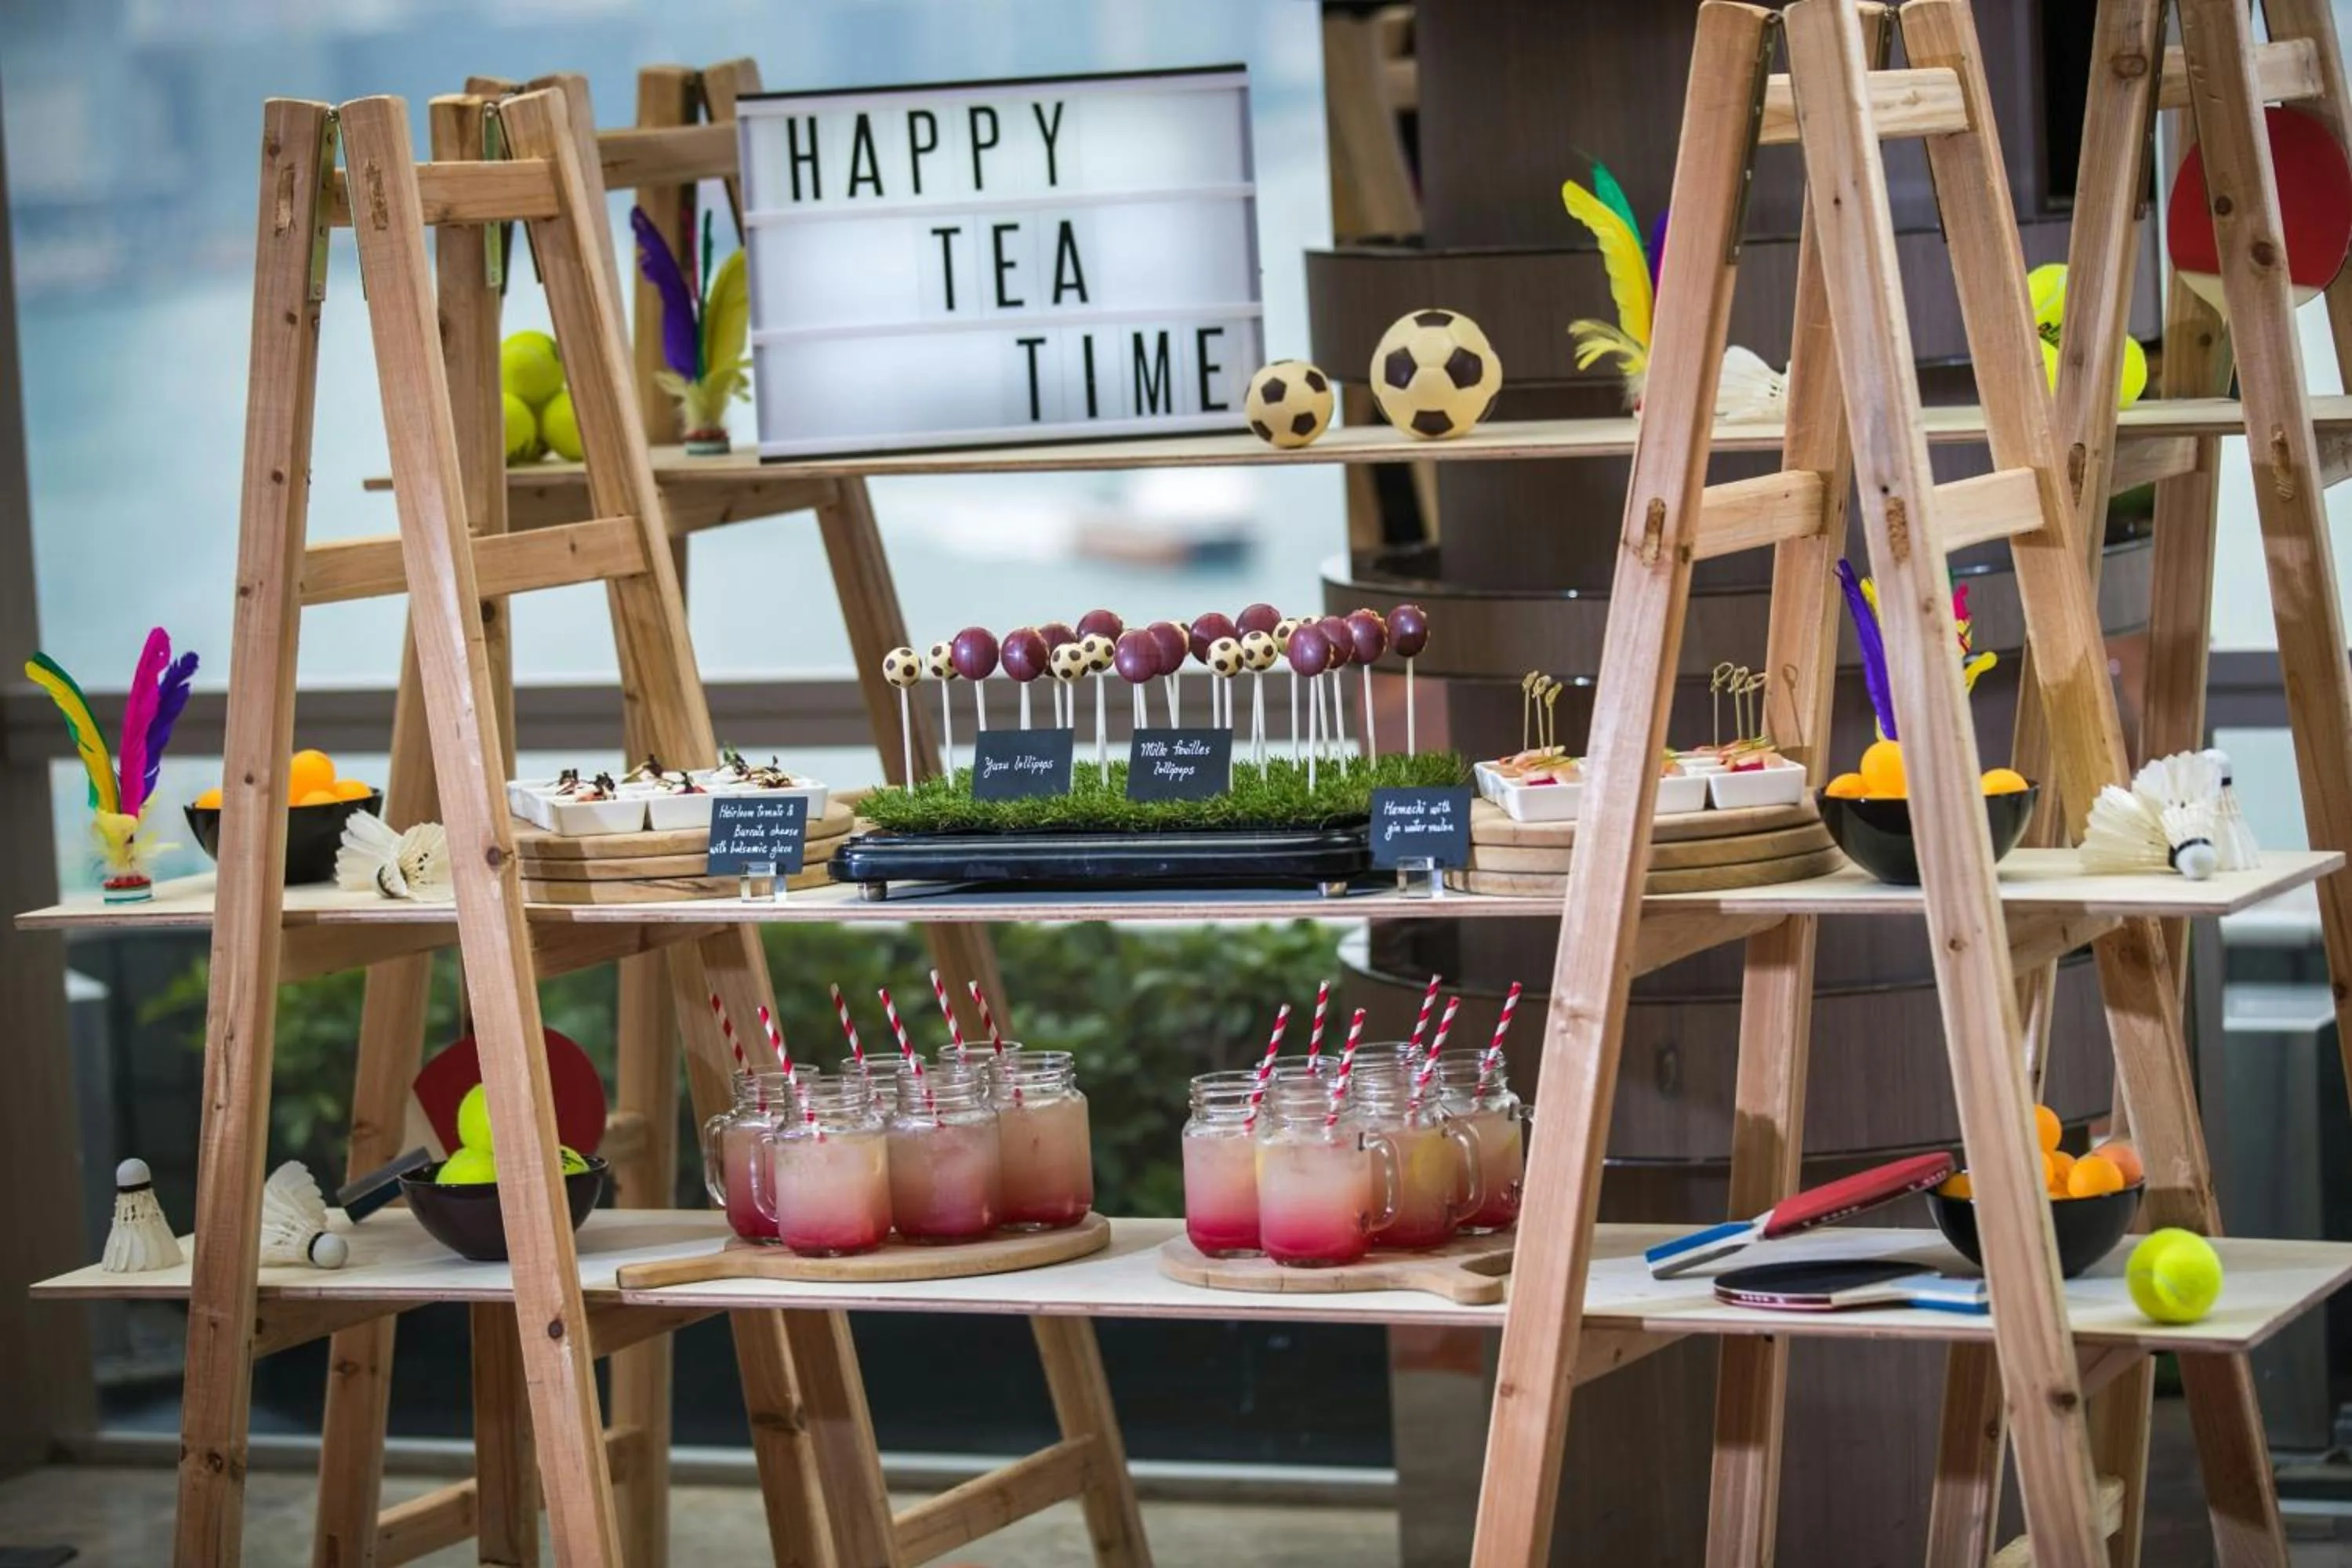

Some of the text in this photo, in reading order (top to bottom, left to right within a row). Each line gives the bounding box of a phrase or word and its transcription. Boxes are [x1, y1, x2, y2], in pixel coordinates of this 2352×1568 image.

[786, 101, 1064, 201] HAPPY
[931, 220, 1089, 312] TEA
[1016, 327, 1229, 422] TIME
[710, 840, 727, 855] with
[1429, 800, 1451, 815] with
